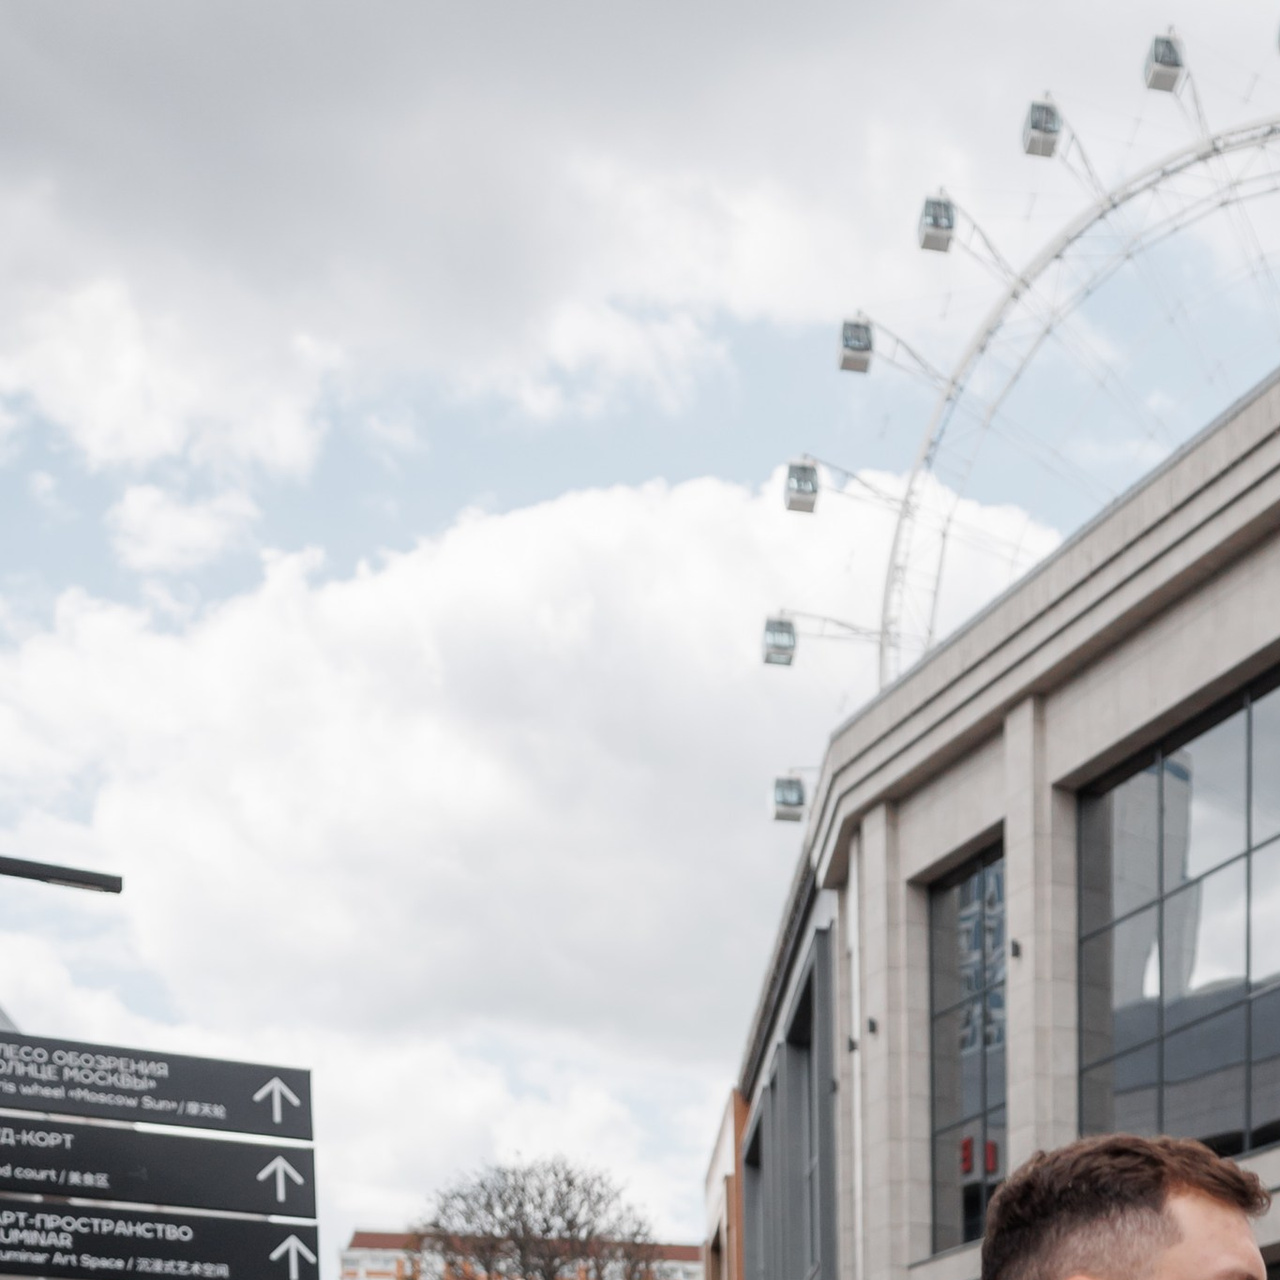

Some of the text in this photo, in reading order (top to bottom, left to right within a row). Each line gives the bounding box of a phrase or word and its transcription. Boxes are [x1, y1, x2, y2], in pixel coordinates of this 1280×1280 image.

[52, 1050, 169, 1078] ОБОЗРЕНИЯ
[19, 1082, 65, 1099] wheel
[0, 1127, 75, 1149] Д-КОРТ
[14, 1166, 57, 1182] court
[0, 1210, 193, 1241] РТ-ПРОСТРАНСТВО
[51, 1252, 78, 1267] Art
[80, 1254, 125, 1271] Space
